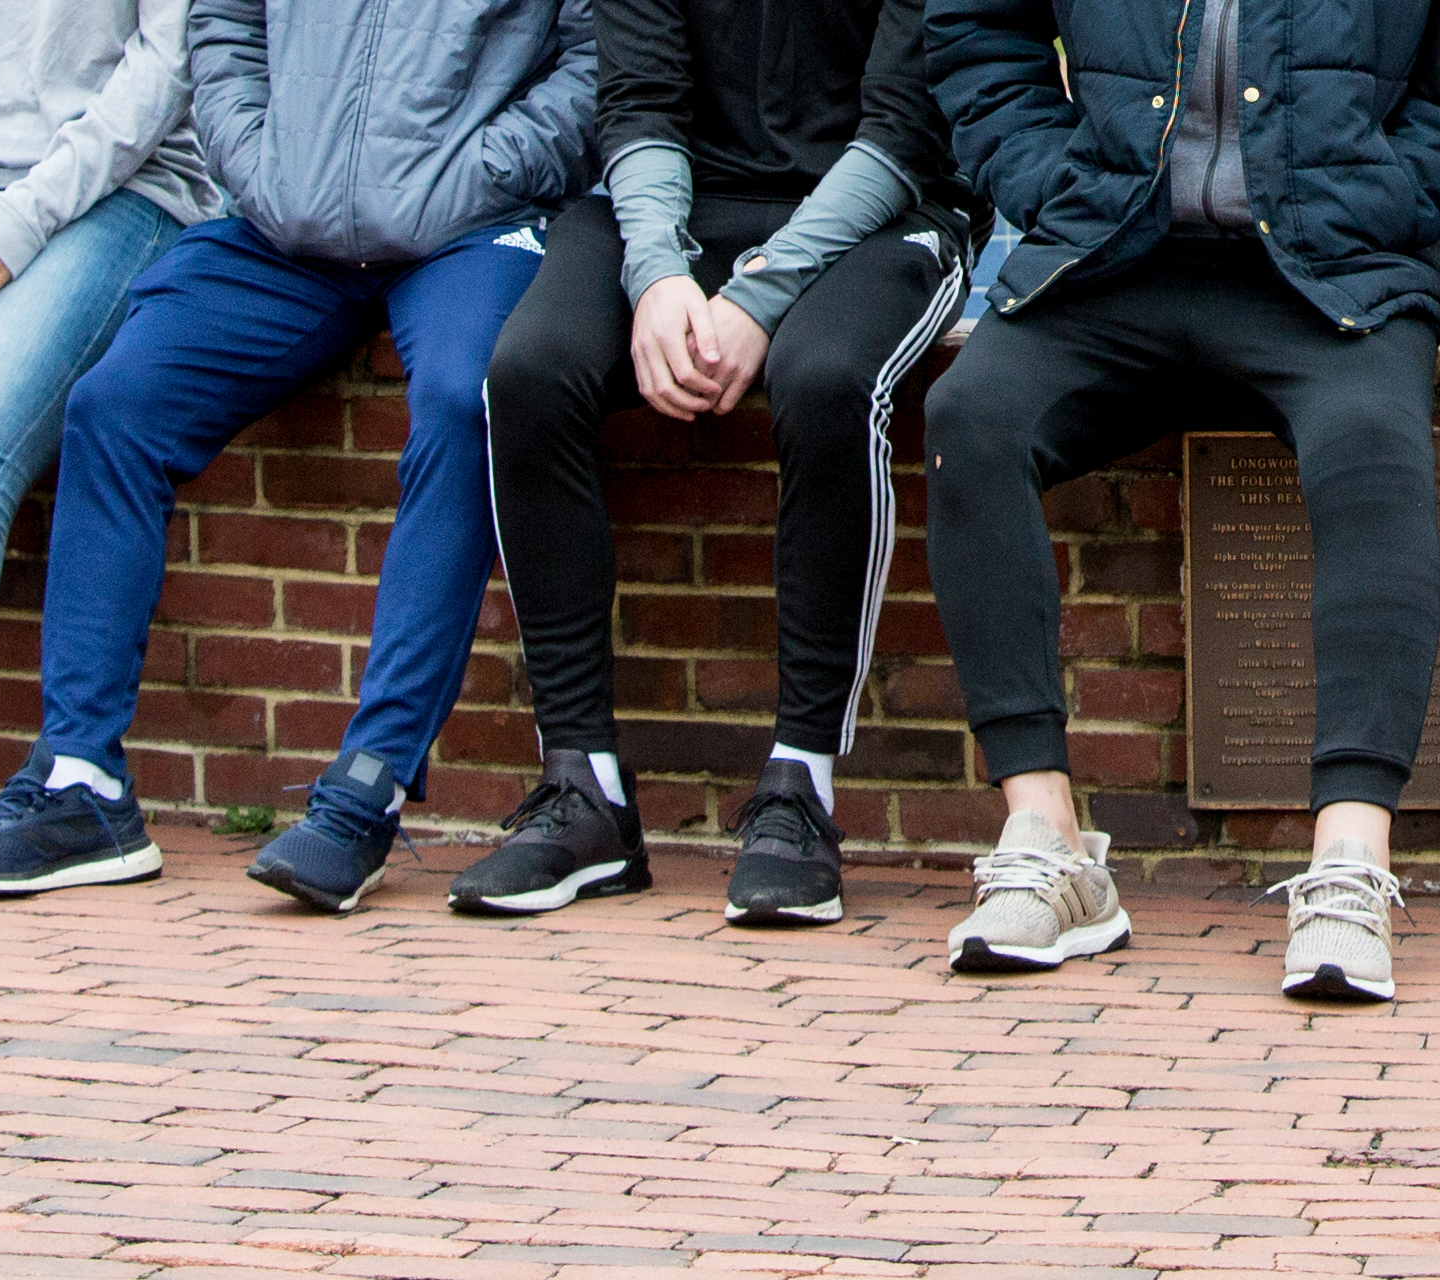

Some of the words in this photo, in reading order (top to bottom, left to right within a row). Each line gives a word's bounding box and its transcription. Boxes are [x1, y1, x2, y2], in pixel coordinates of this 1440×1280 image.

[1231, 458, 1298, 469] LONGWOO
[1210, 476, 1235, 487] THE
[1241, 476, 1301, 487] FOLLOWI
[1240, 493, 1271, 504] THIS
